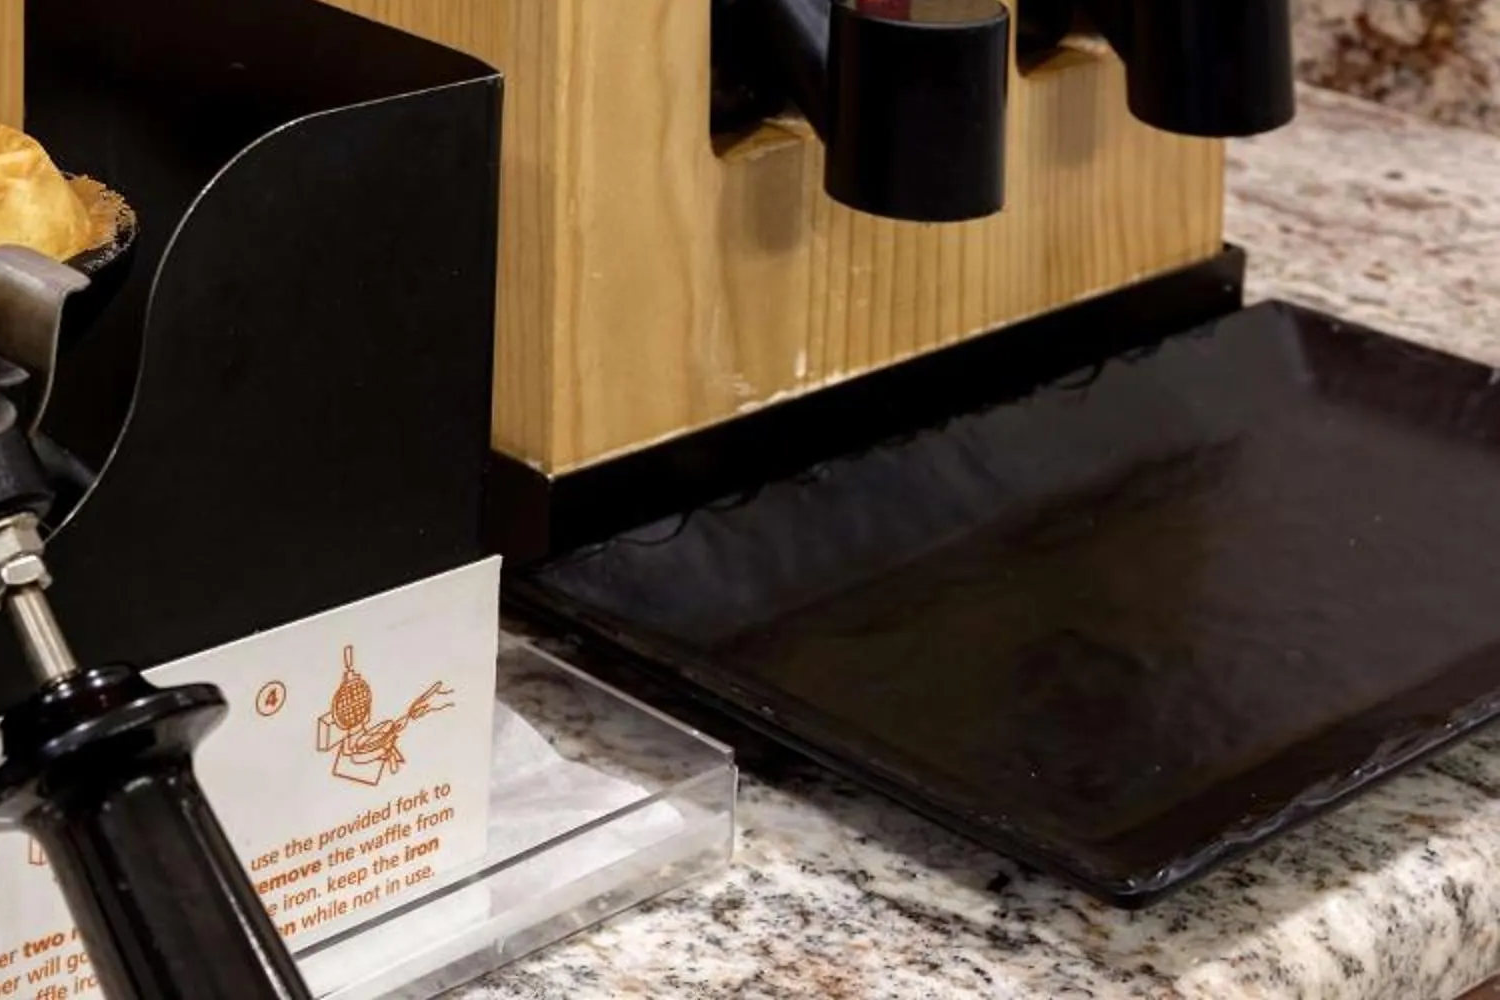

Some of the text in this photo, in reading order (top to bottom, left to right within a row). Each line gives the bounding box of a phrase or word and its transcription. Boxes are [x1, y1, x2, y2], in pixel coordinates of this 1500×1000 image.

[251, 782, 451, 871] use the provided fork to
[256, 807, 455, 895] emove the waffle from
[283, 889, 322, 911] iron.
[327, 866, 368, 893] keep
[372, 855, 400, 876] the
[404, 837, 440, 863] iron
[301, 899, 349, 926] while
[353, 885, 381, 910] not
[385, 877, 400, 896] in
[405, 865, 436, 887] use.
[22, 932, 65, 958] two
[27, 955, 61, 985] will
[33, 974, 99, 1000] ffle iro
